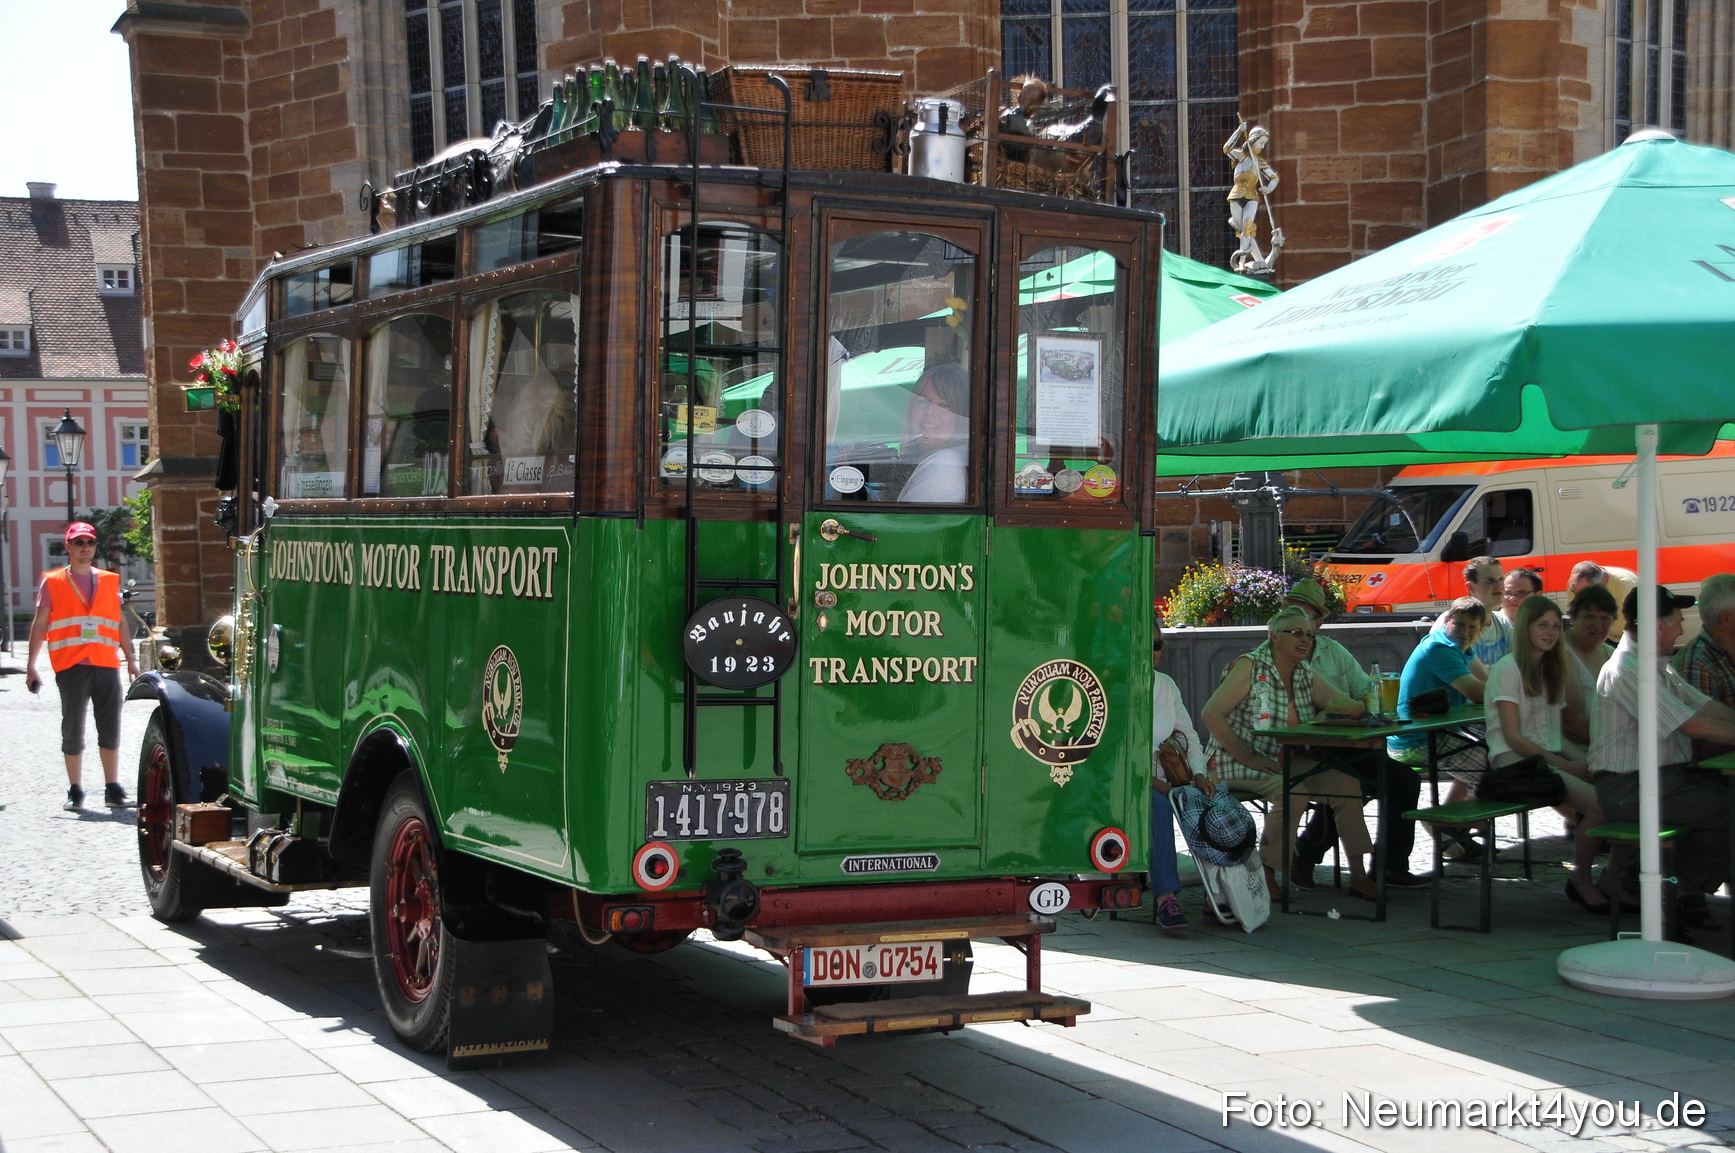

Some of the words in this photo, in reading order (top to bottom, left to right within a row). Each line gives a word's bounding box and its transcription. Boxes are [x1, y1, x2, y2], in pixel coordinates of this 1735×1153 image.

[516, 462, 542, 482] Classe
[836, 474, 859, 486] Eingang
[269, 539, 354, 586] JOHNSTON'S
[361, 543, 421, 590] MOTOR
[430, 545, 558, 598] TRANSPORT
[815, 562, 974, 592] JOHNSTON'S
[688, 603, 791, 645] Baujahr
[845, 610, 943, 637] MOTOR
[709, 655, 775, 673] 1923
[809, 656, 977, 685] TRANSPORT
[1018, 663, 1070, 705] NUNQUAM
[1072, 666, 1096, 689] NON
[1086, 687, 1105, 739] PARATUS
[848, 856, 935, 872] INTERNATIONAL
[1035, 890, 1065, 908] GB
[813, 949, 860, 981] DON
[880, 946, 938, 978] 0754
[454, 1038, 548, 1053] INTERNATIONAL
